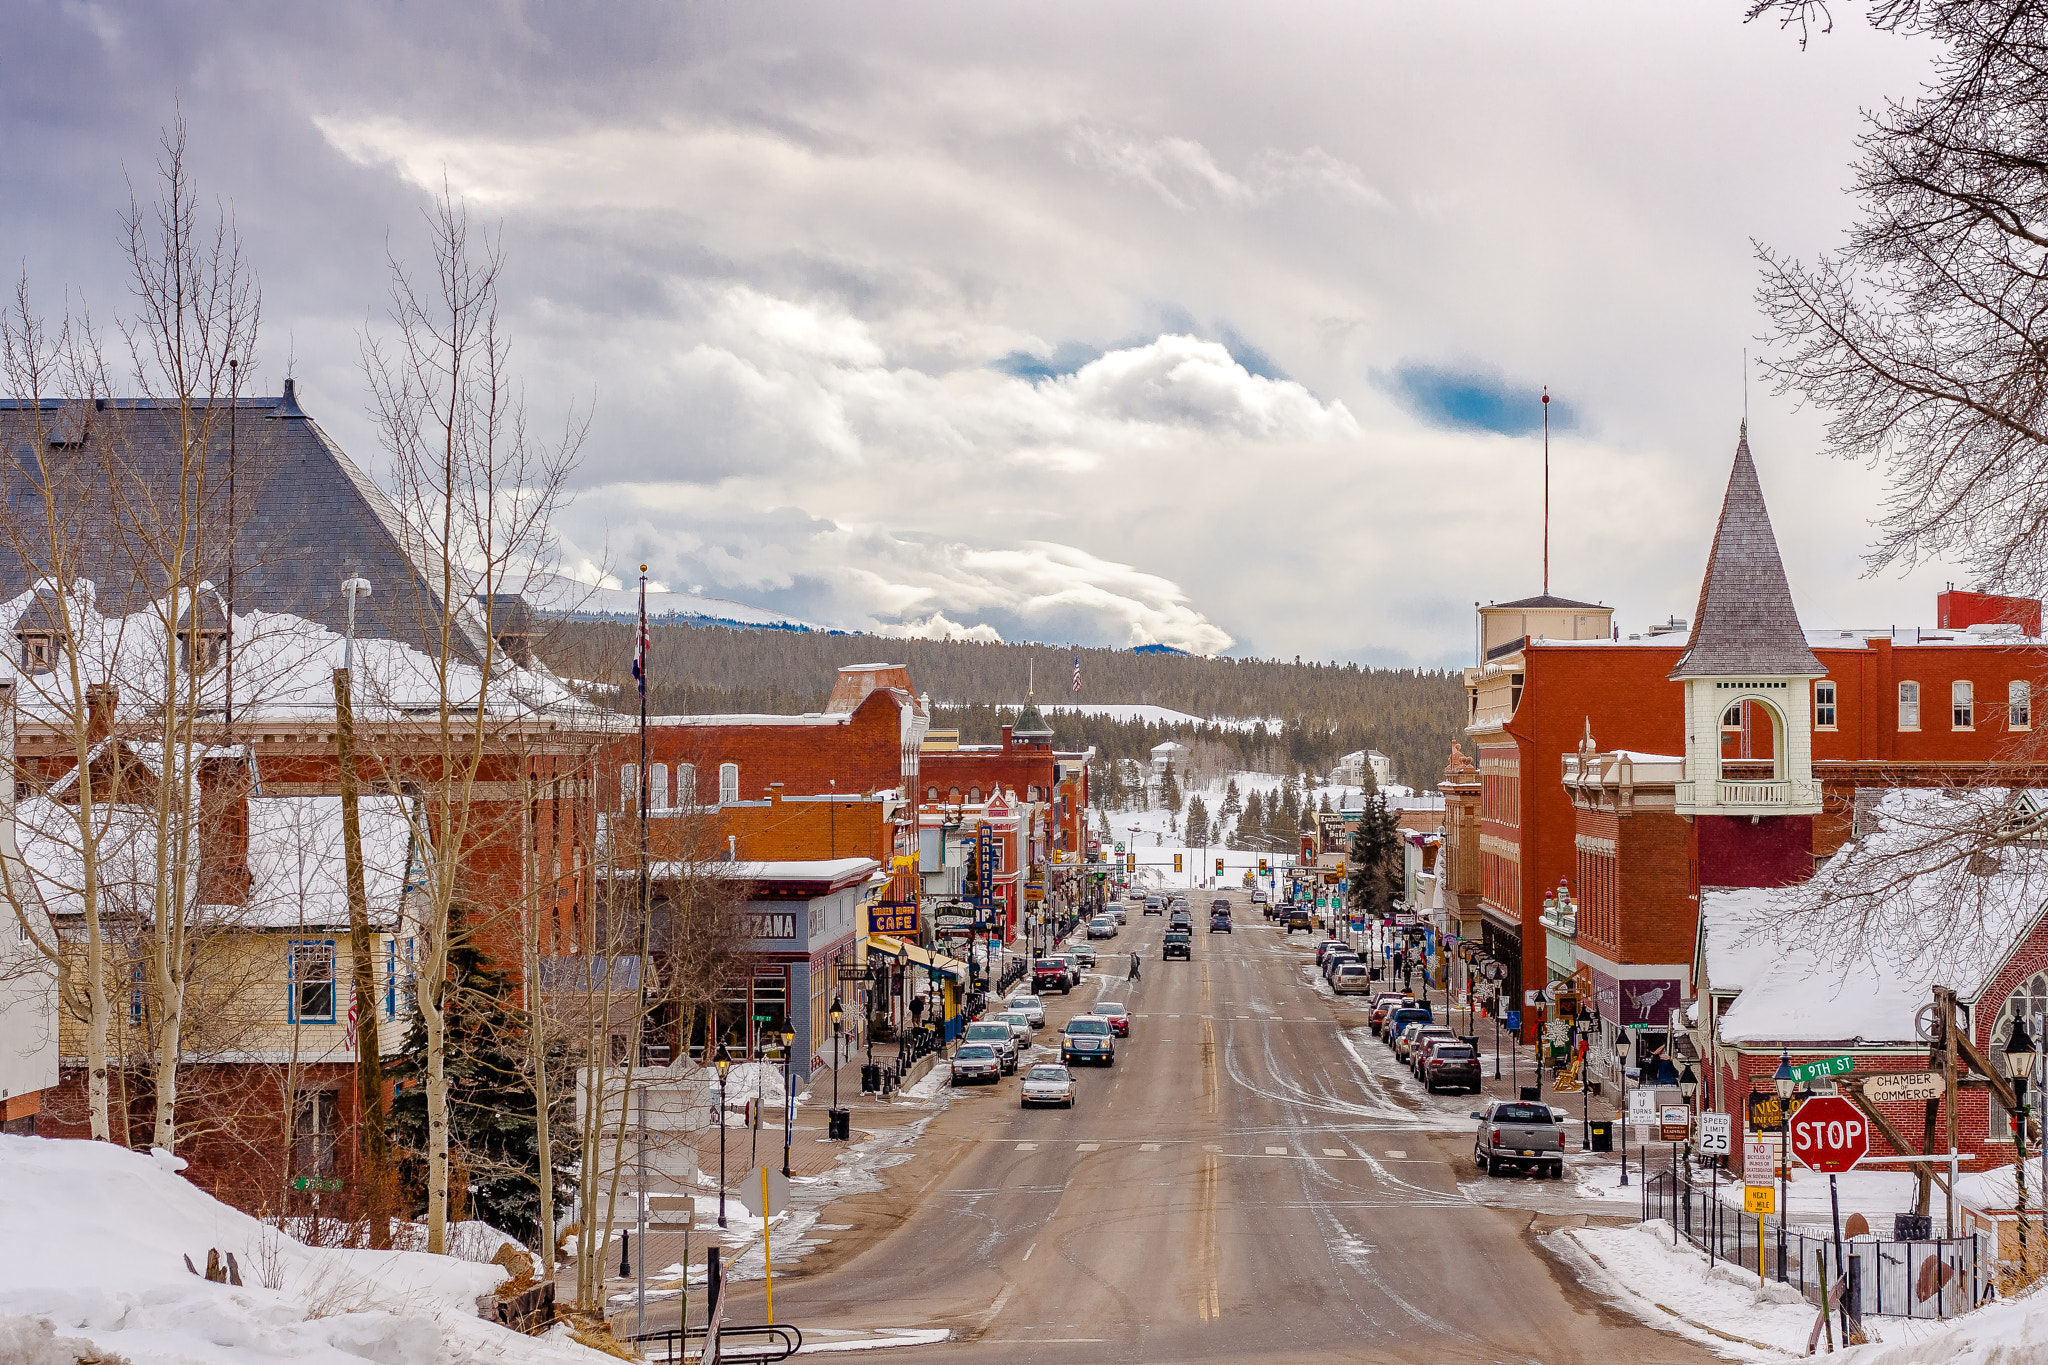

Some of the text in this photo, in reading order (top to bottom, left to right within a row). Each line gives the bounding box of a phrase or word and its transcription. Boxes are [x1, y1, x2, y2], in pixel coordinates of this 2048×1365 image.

[876, 915, 912, 931] CAFE
[1791, 1057, 1850, 1081] W 9TH ST
[1876, 1074, 1932, 1087] CHAMBER
[1873, 1088, 1937, 1102] COMMERCE
[1639, 1099, 1645, 1107] U
[1703, 1117, 1729, 1125] SPEED
[1705, 1125, 1725, 1133] LIMIT
[1796, 1120, 1862, 1150] STOP
[1702, 1134, 1728, 1149] 25
[1753, 1145, 1765, 1154] NO
[1756, 1200, 1770, 1209] MILE
